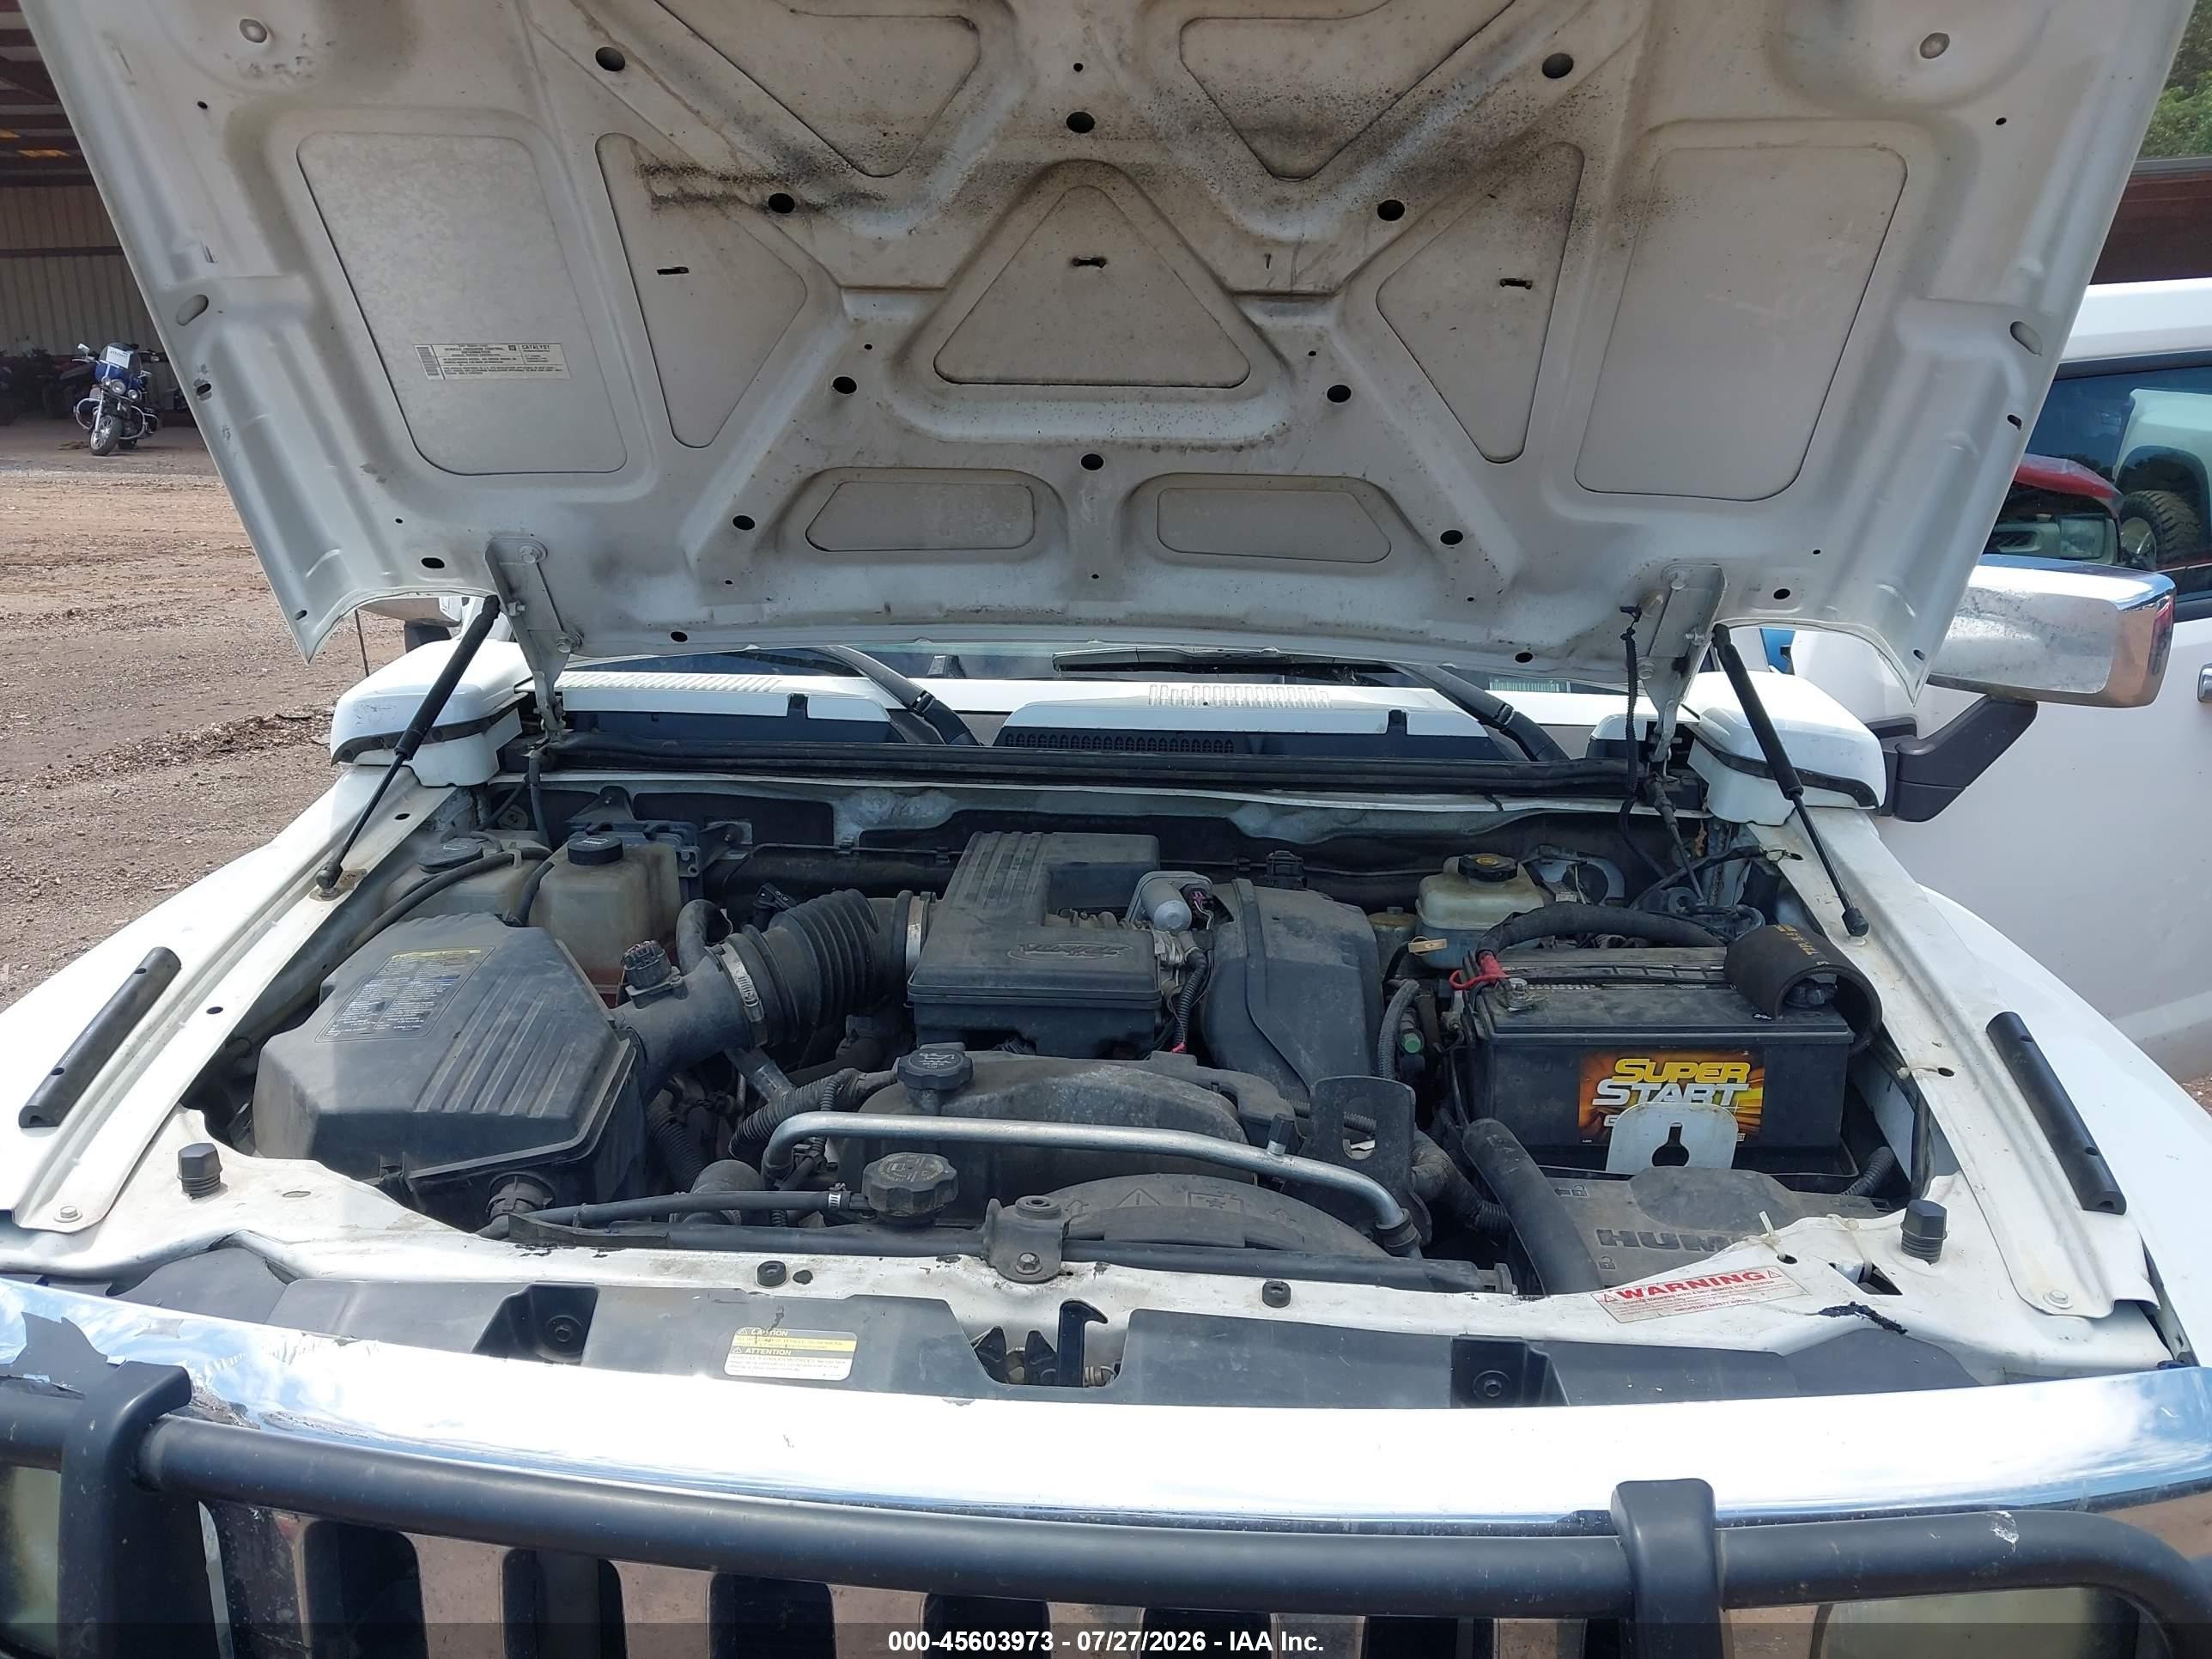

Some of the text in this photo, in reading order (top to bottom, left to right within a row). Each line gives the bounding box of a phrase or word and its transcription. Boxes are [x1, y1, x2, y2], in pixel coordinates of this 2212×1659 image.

[1612, 1058, 1751, 1084] SUPER
[1591, 1079, 1749, 1106] START
[1617, 1272, 1765, 1299] WARNING
[744, 1348, 792, 1357] ATTENTION
